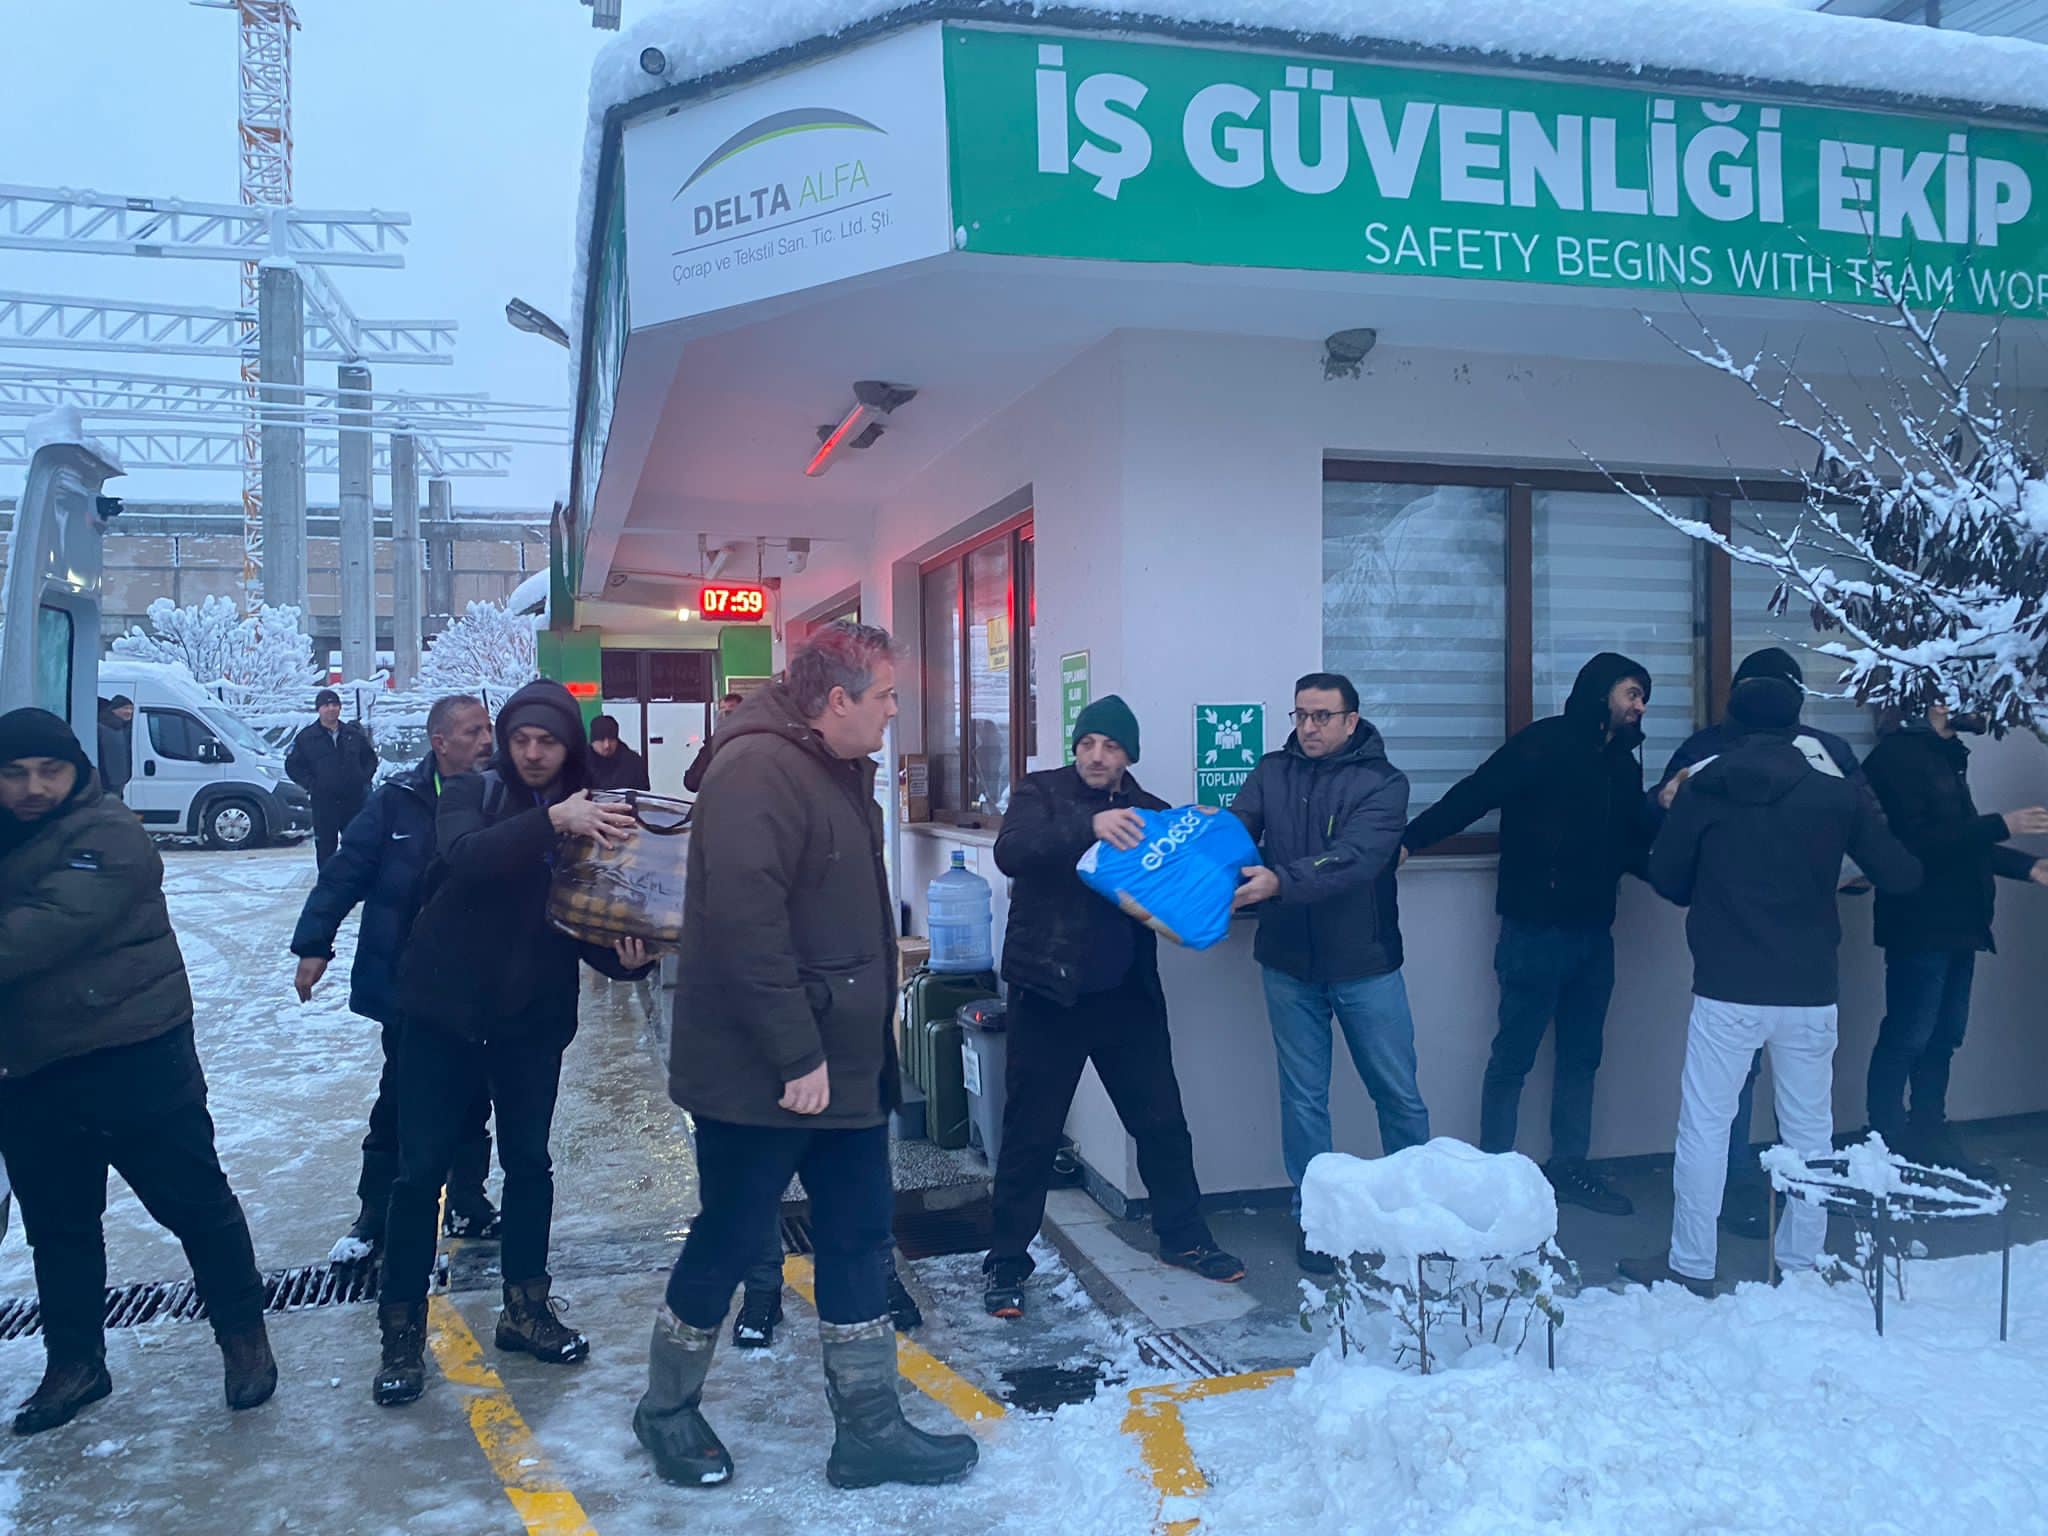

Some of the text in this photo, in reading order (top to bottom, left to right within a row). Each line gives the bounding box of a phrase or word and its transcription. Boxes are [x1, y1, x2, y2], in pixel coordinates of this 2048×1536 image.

[1036, 44, 2032, 246] İŞ GÜVENLİĞİ EKİP
[693, 159, 870, 236] DELTA ALFA
[672, 208, 894, 286] Çorap ve Tekstil San. Tic. Ltd. Şti.
[1365, 222, 1539, 274] SAFETY
[1556, 236, 1713, 286] BEGINS
[1727, 248, 1833, 295] WITH
[1846, 258, 1954, 304] TEAM
[703, 588, 763, 614] 07:59
[1199, 772, 1248, 787] TOPLAN
